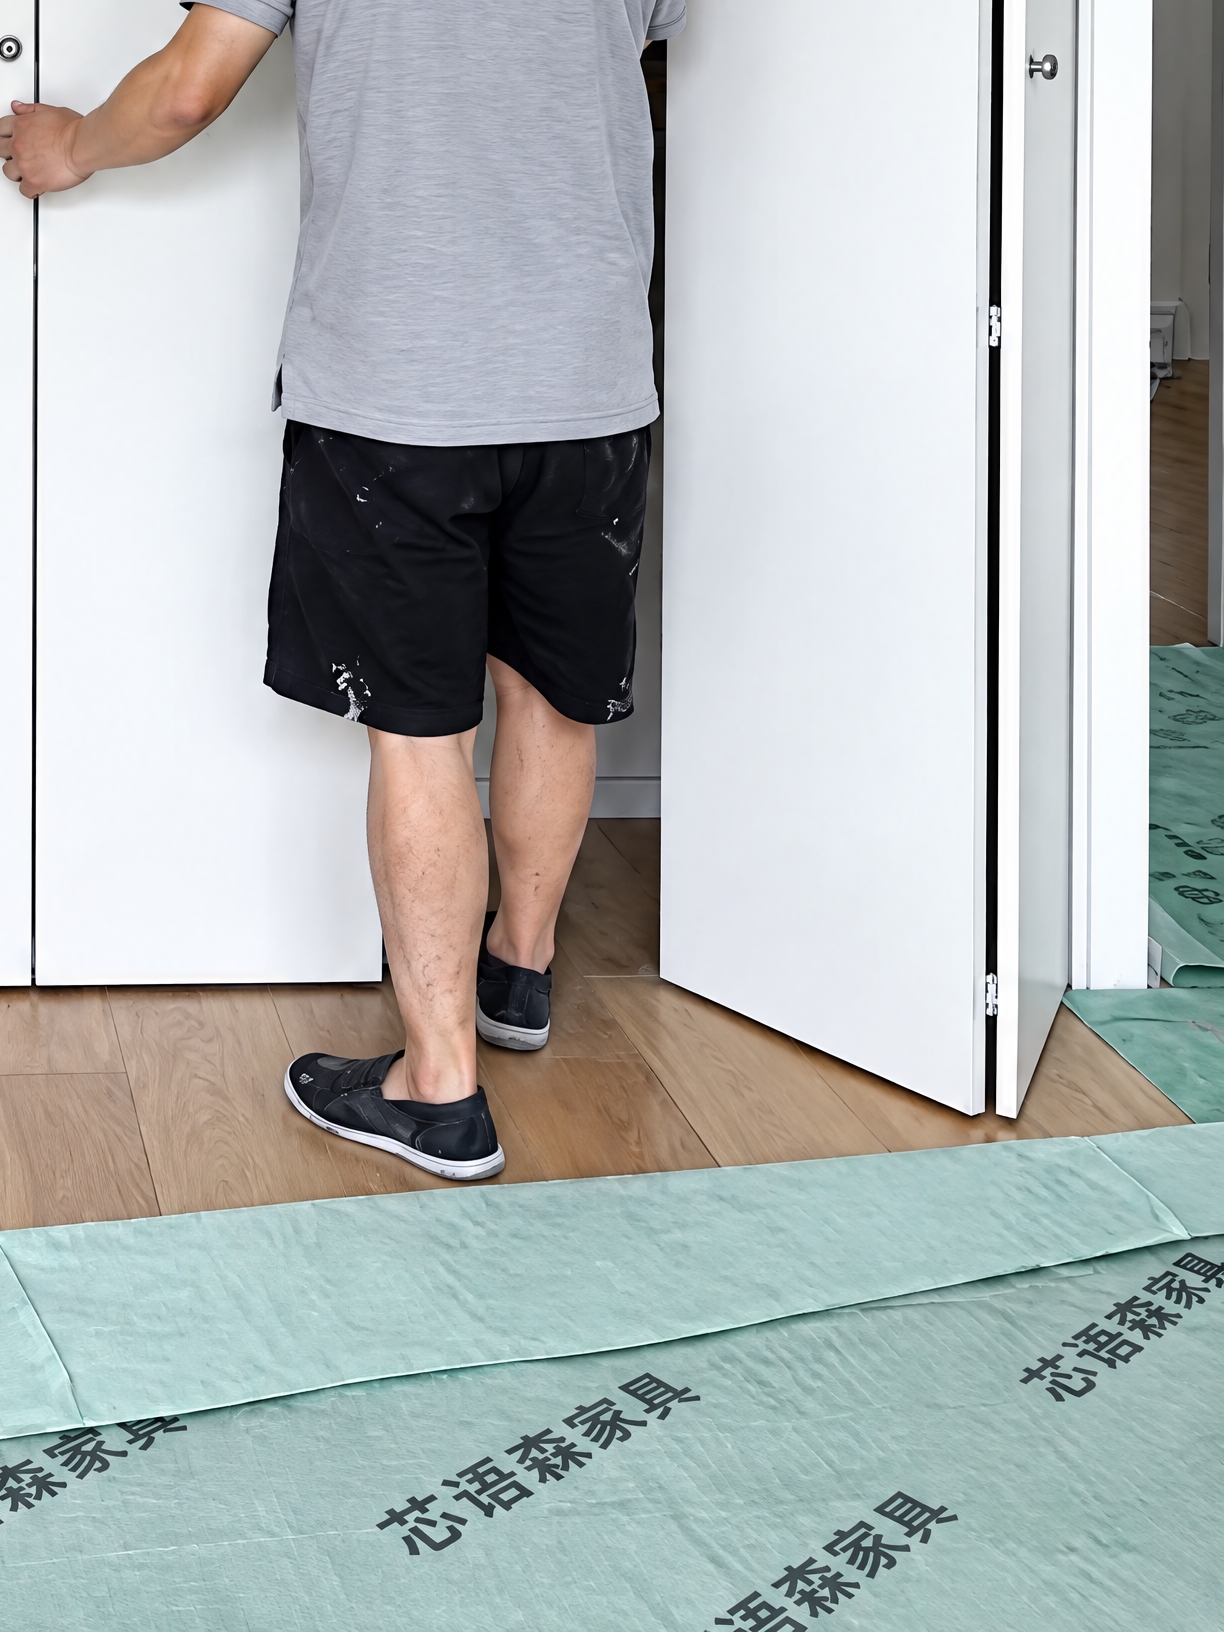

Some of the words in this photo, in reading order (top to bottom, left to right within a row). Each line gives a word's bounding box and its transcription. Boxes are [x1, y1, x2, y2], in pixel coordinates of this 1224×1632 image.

[1019, 1252, 1224, 1402] 芯语森家具
[376, 1372, 701, 1556] 芯语森家具
